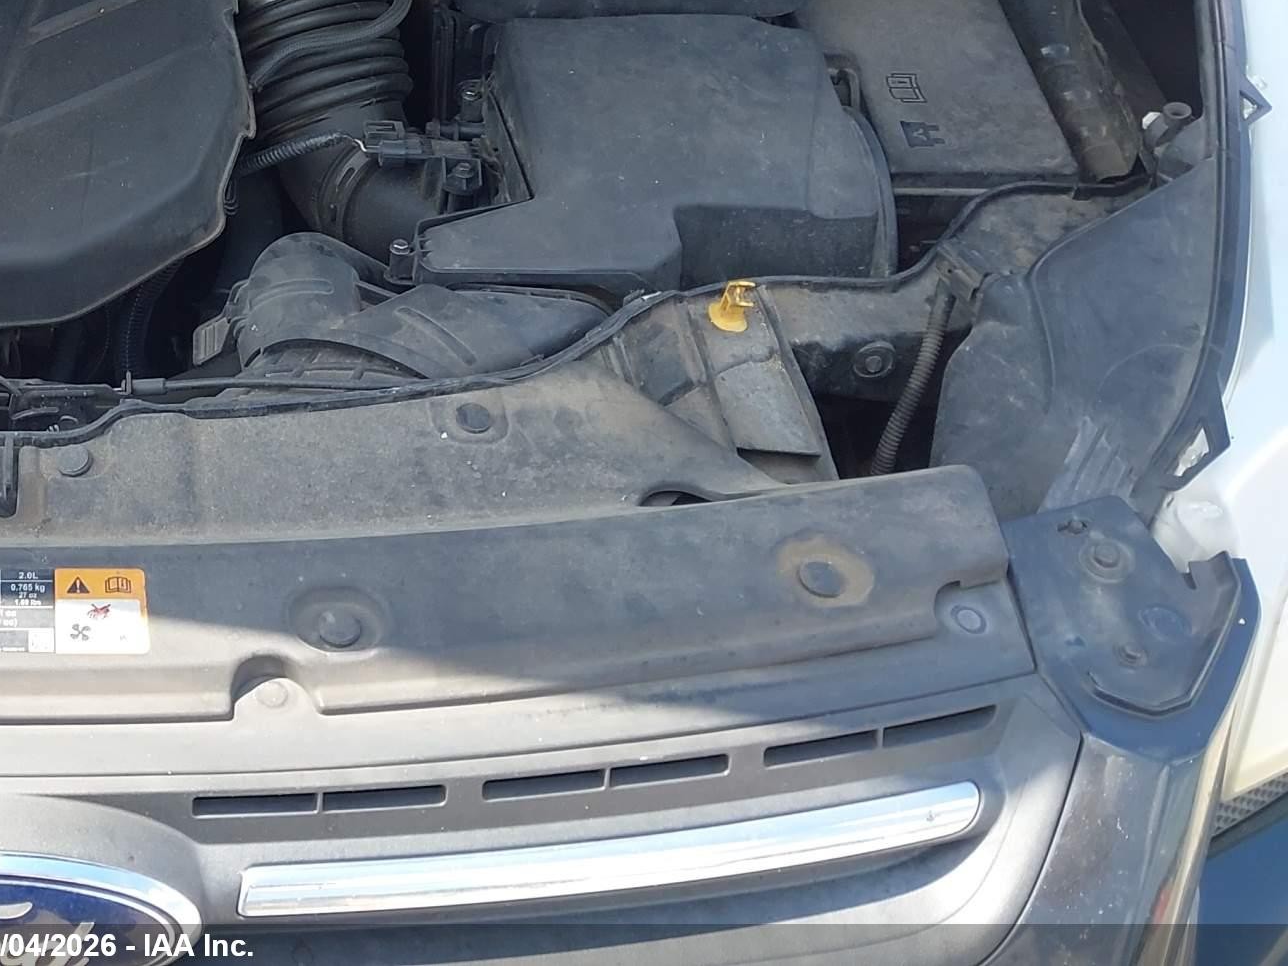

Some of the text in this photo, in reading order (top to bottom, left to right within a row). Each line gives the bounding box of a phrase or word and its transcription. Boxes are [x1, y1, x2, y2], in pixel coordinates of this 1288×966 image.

[18, 571, 39, 579] 2.0L
[10, 583, 46, 593] 0.765 kg
